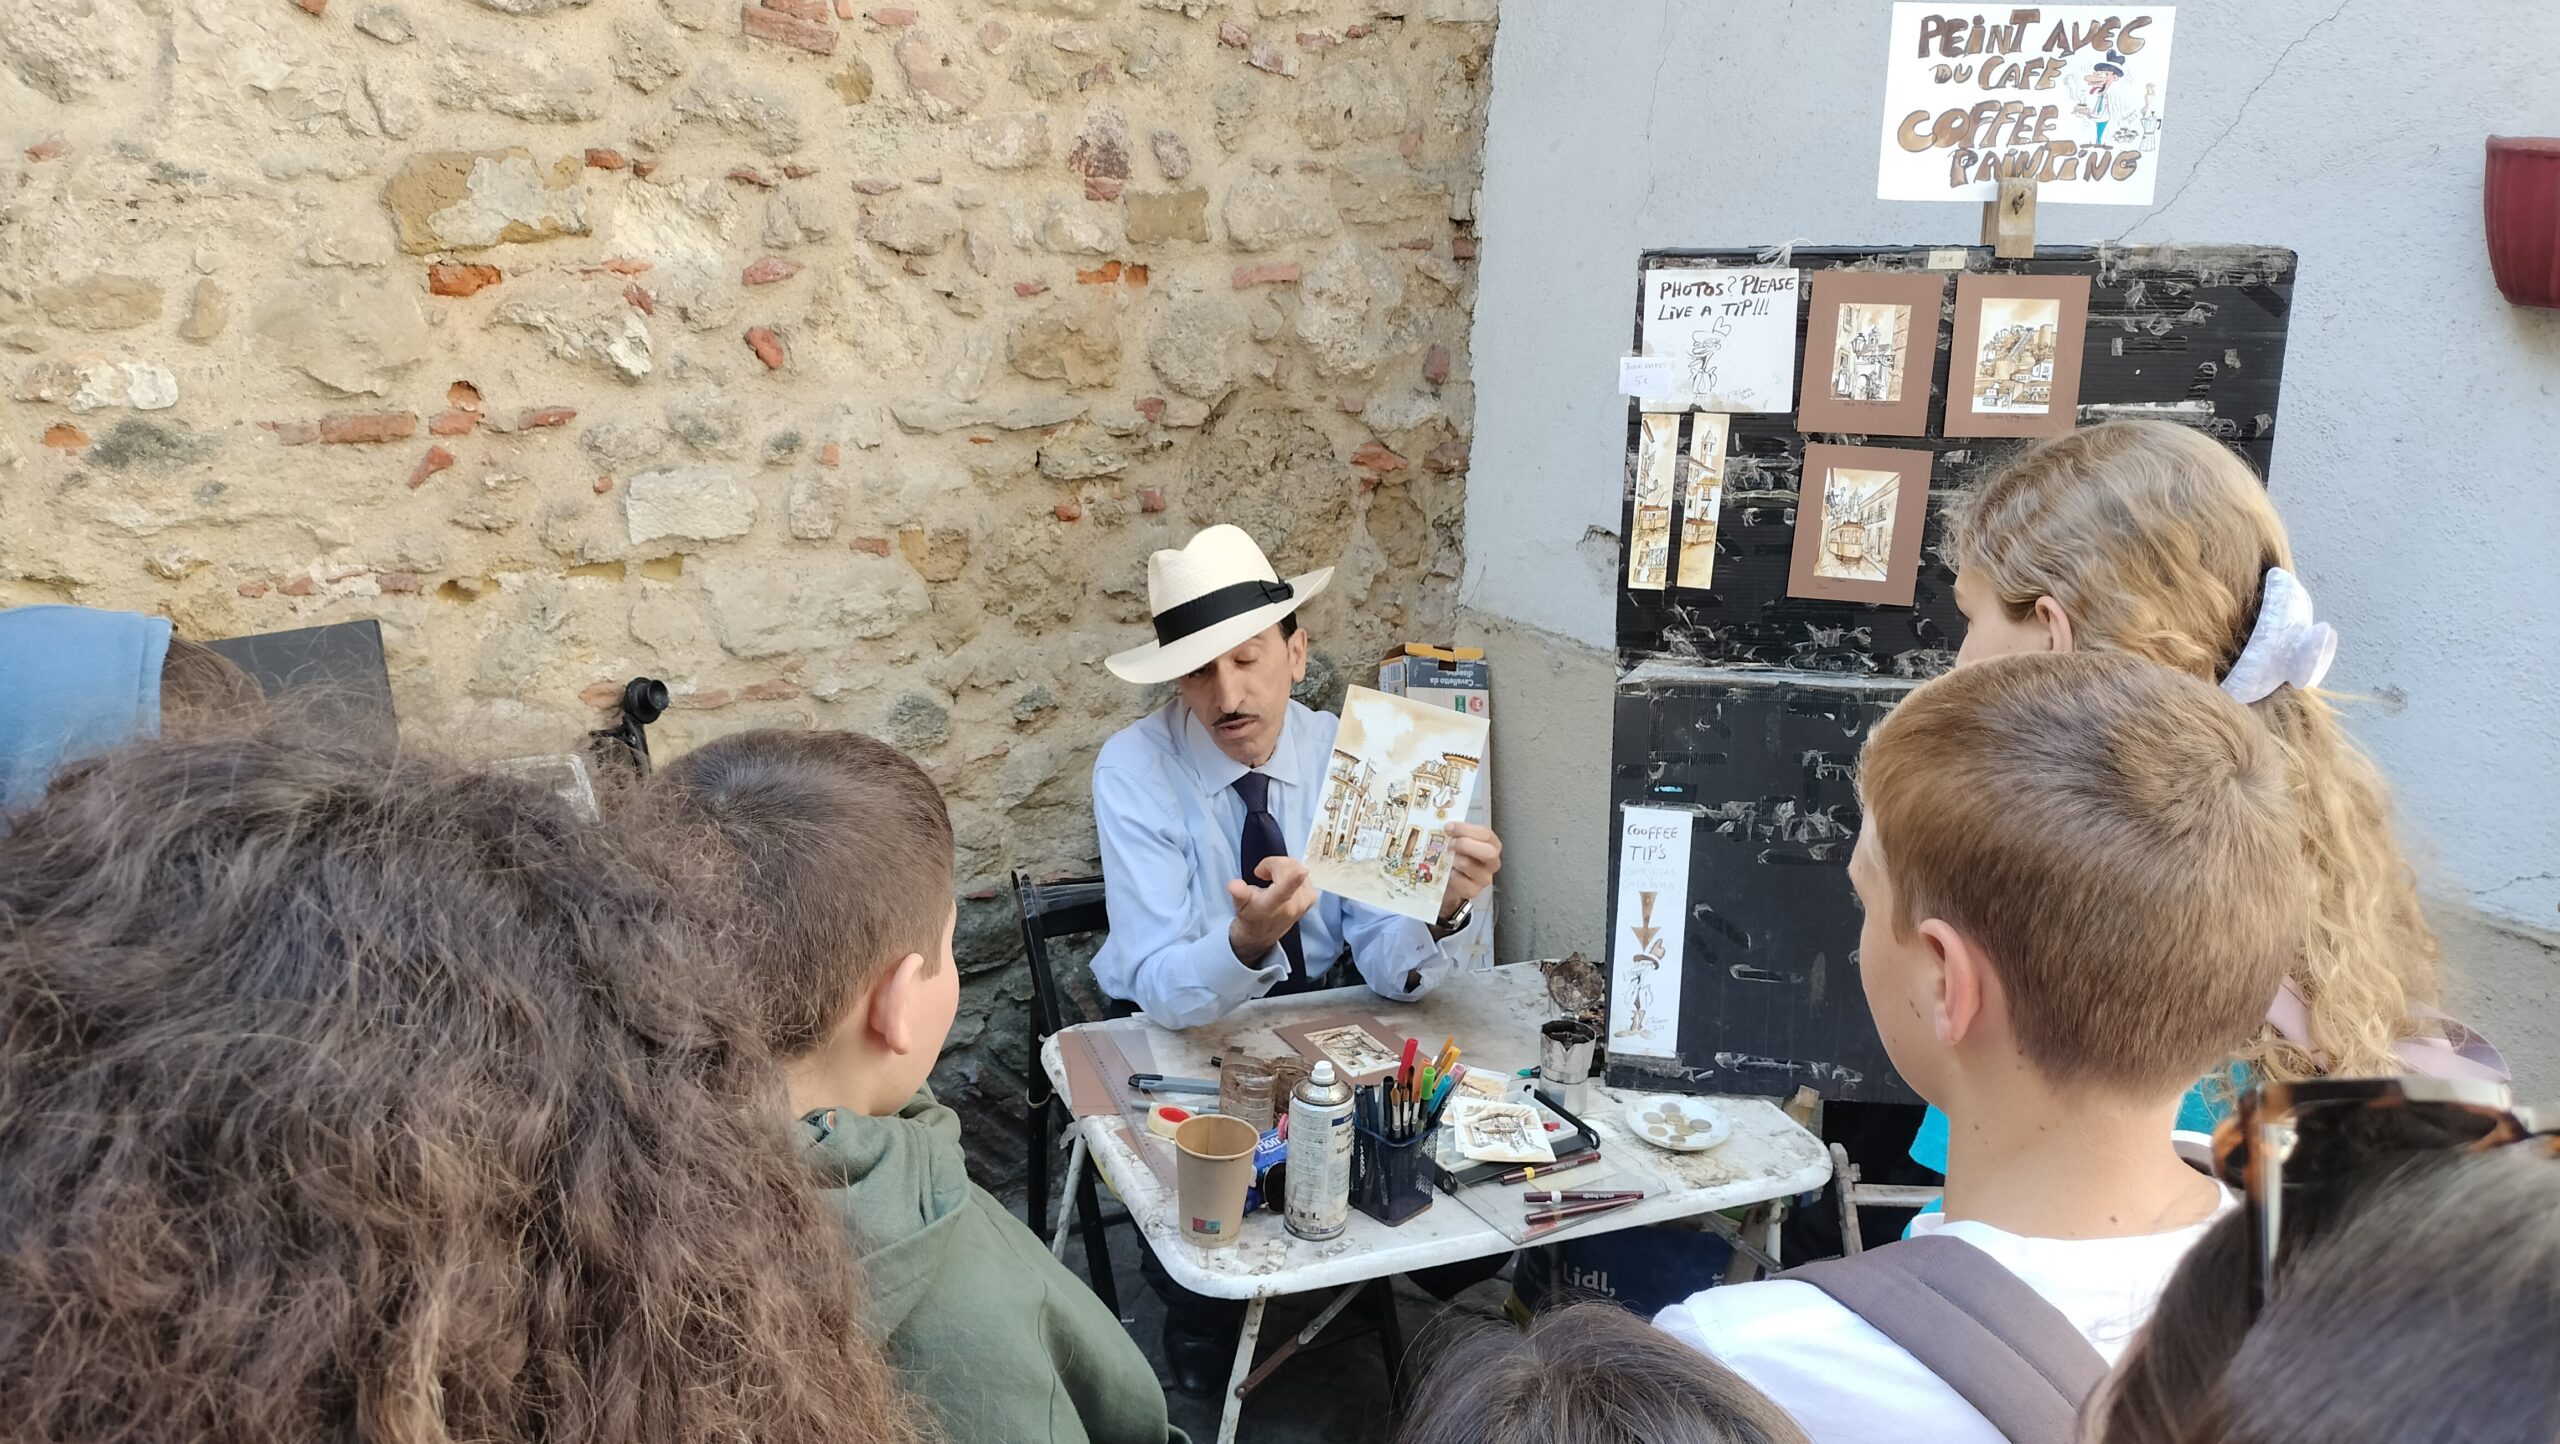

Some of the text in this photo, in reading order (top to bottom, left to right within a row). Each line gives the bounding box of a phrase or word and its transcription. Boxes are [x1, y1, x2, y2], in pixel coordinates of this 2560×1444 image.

[2042, 15, 2152, 57] AVEC
[1929, 63, 1973, 84] DU
[1897, 100, 2059, 152] COFFEE
[1740, 274, 1796, 296] PLEASE
[1700, 305, 1712, 317] A
[1430, 676, 1474, 687] Cavalletto da
